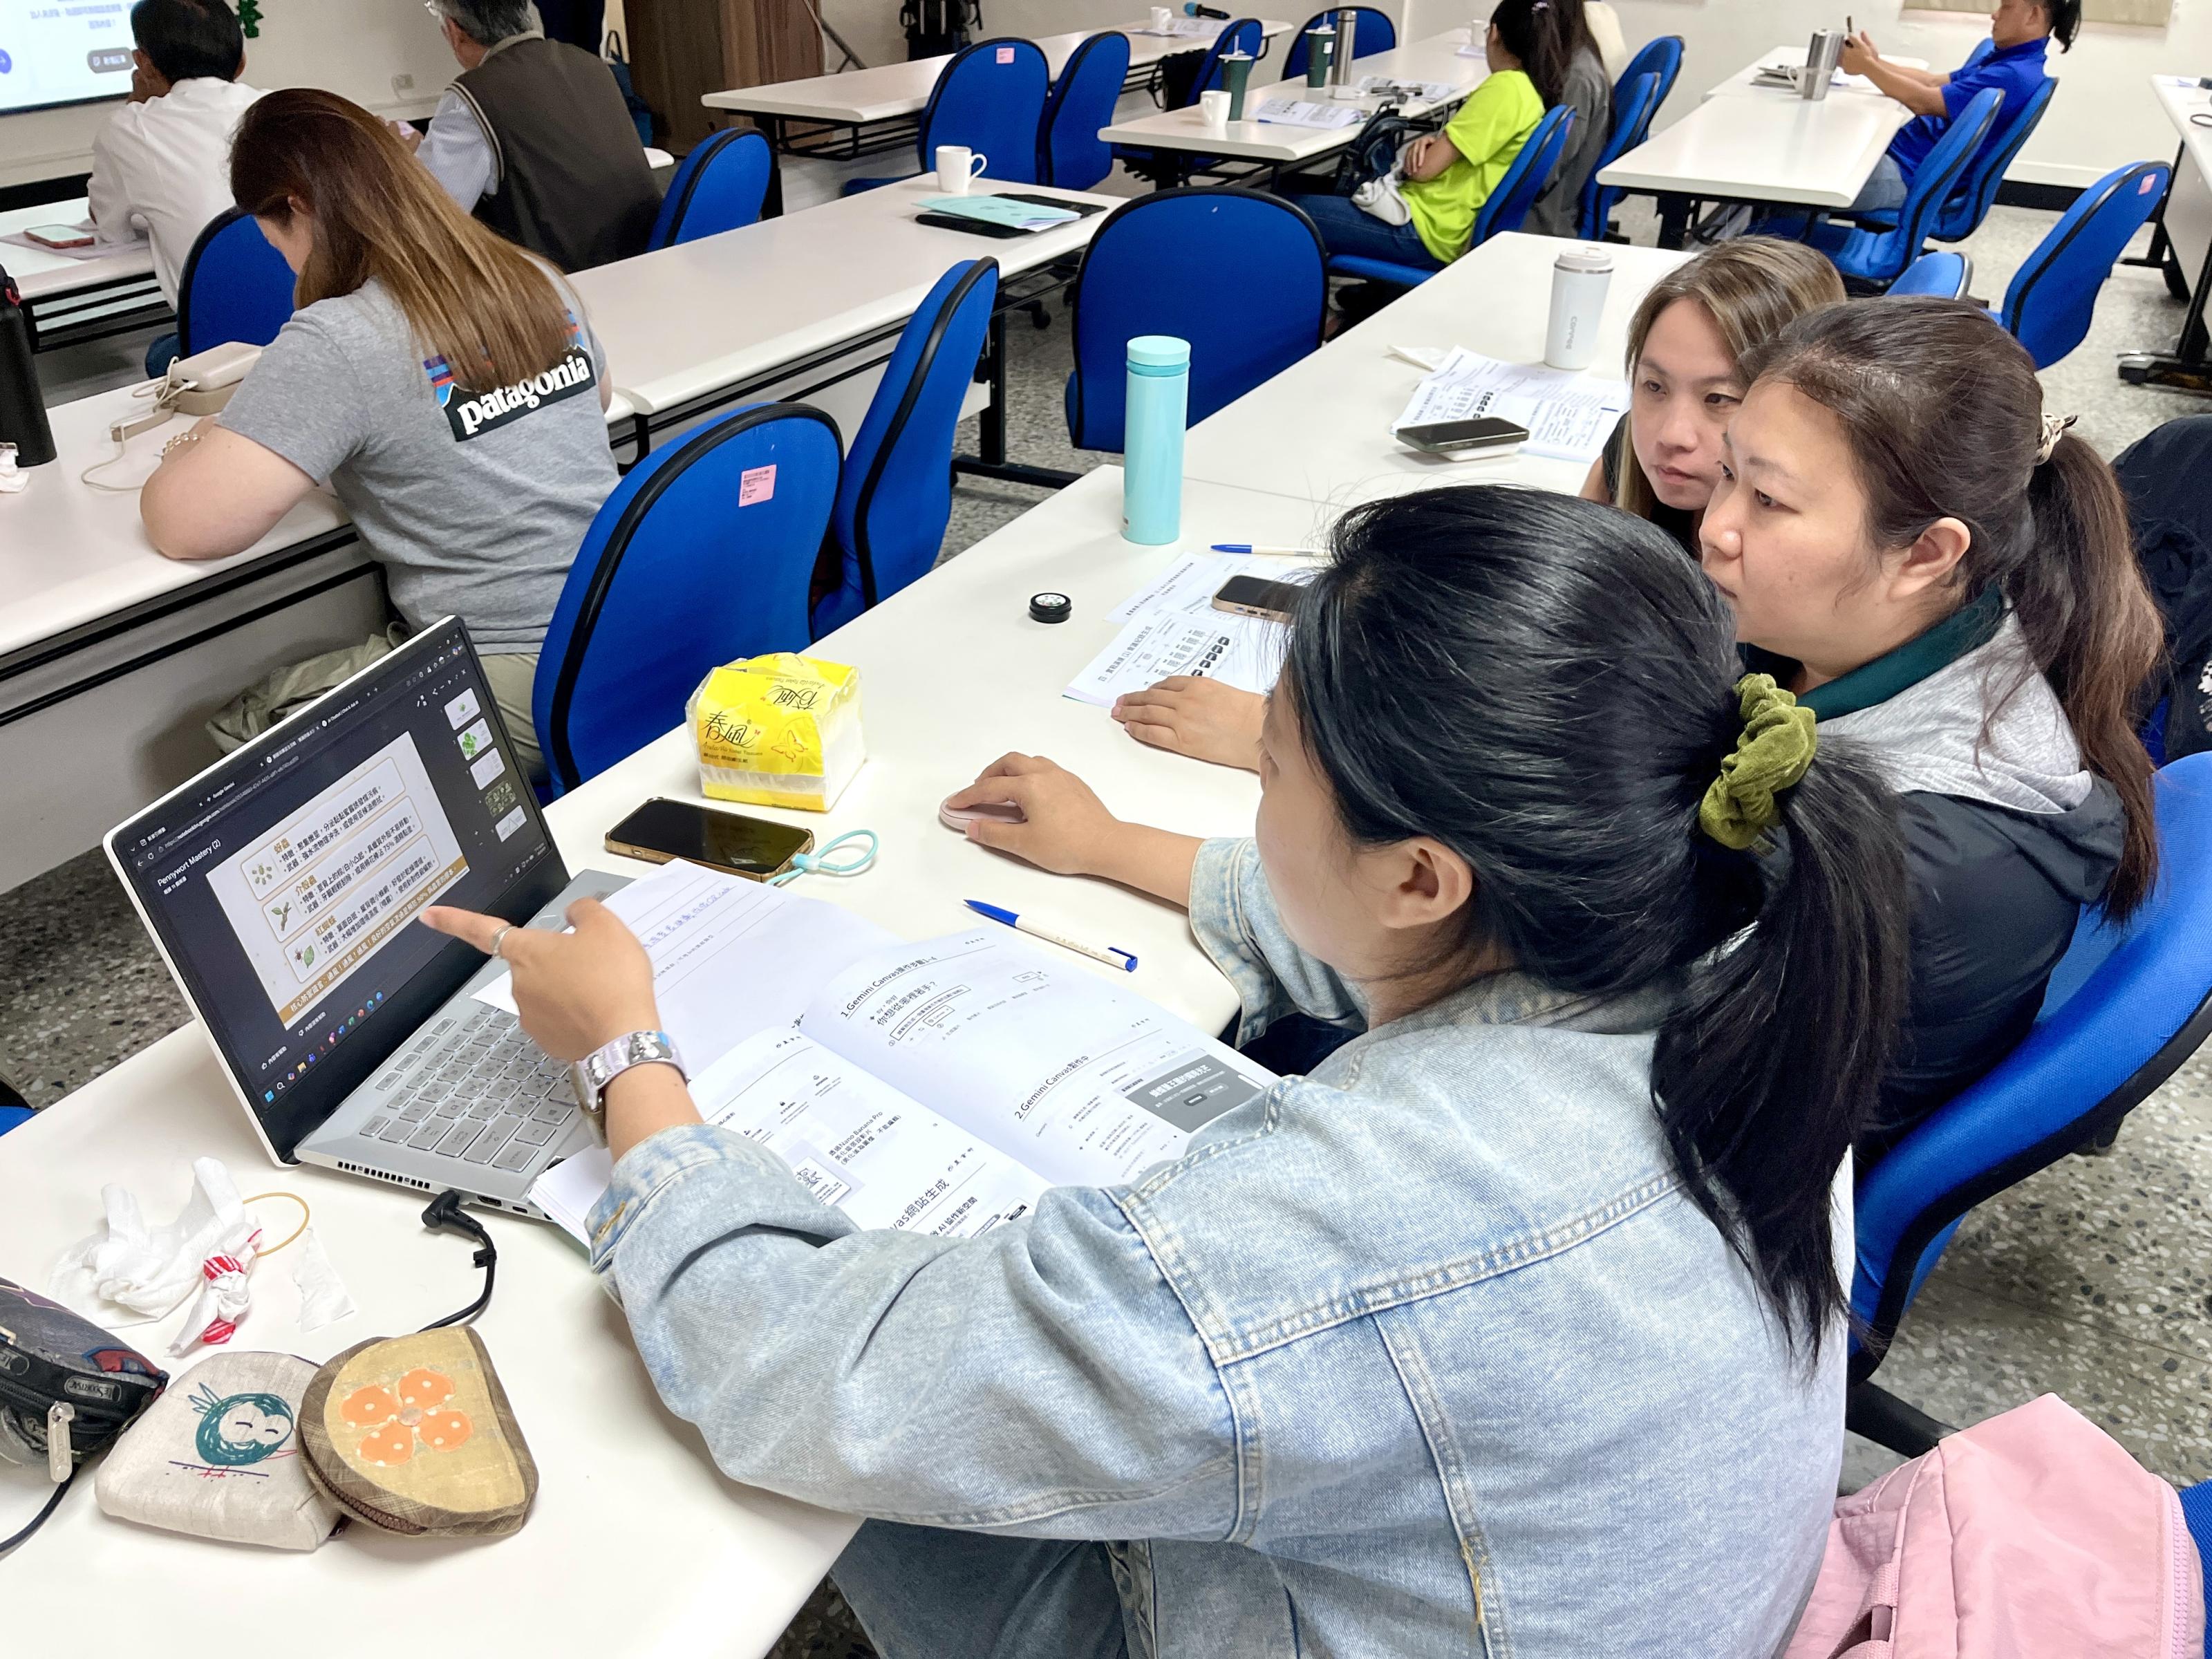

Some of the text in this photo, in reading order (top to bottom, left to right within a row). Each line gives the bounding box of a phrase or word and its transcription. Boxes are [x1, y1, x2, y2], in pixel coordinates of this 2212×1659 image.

[457, 355, 591, 435] patagonia
[703, 711, 758, 749] 春風
[156, 837, 222, 888] Pennywort Mastery (2)
[272, 836, 290, 855] 蚜蟲
[382, 838, 395, 853] 75%
[294, 872, 317, 897] 介殼蟲
[313, 913, 337, 938] 紅蜘蛛
[840, 984, 876, 1019] 1.Gemini
[1013, 1082, 1049, 1120] 2.Gemini
[1044, 1053, 1089, 1087] Canvas製作中
[828, 1109, 884, 1157] 透過Nano Banana Pro
[937, 1221, 948, 1232] AI
